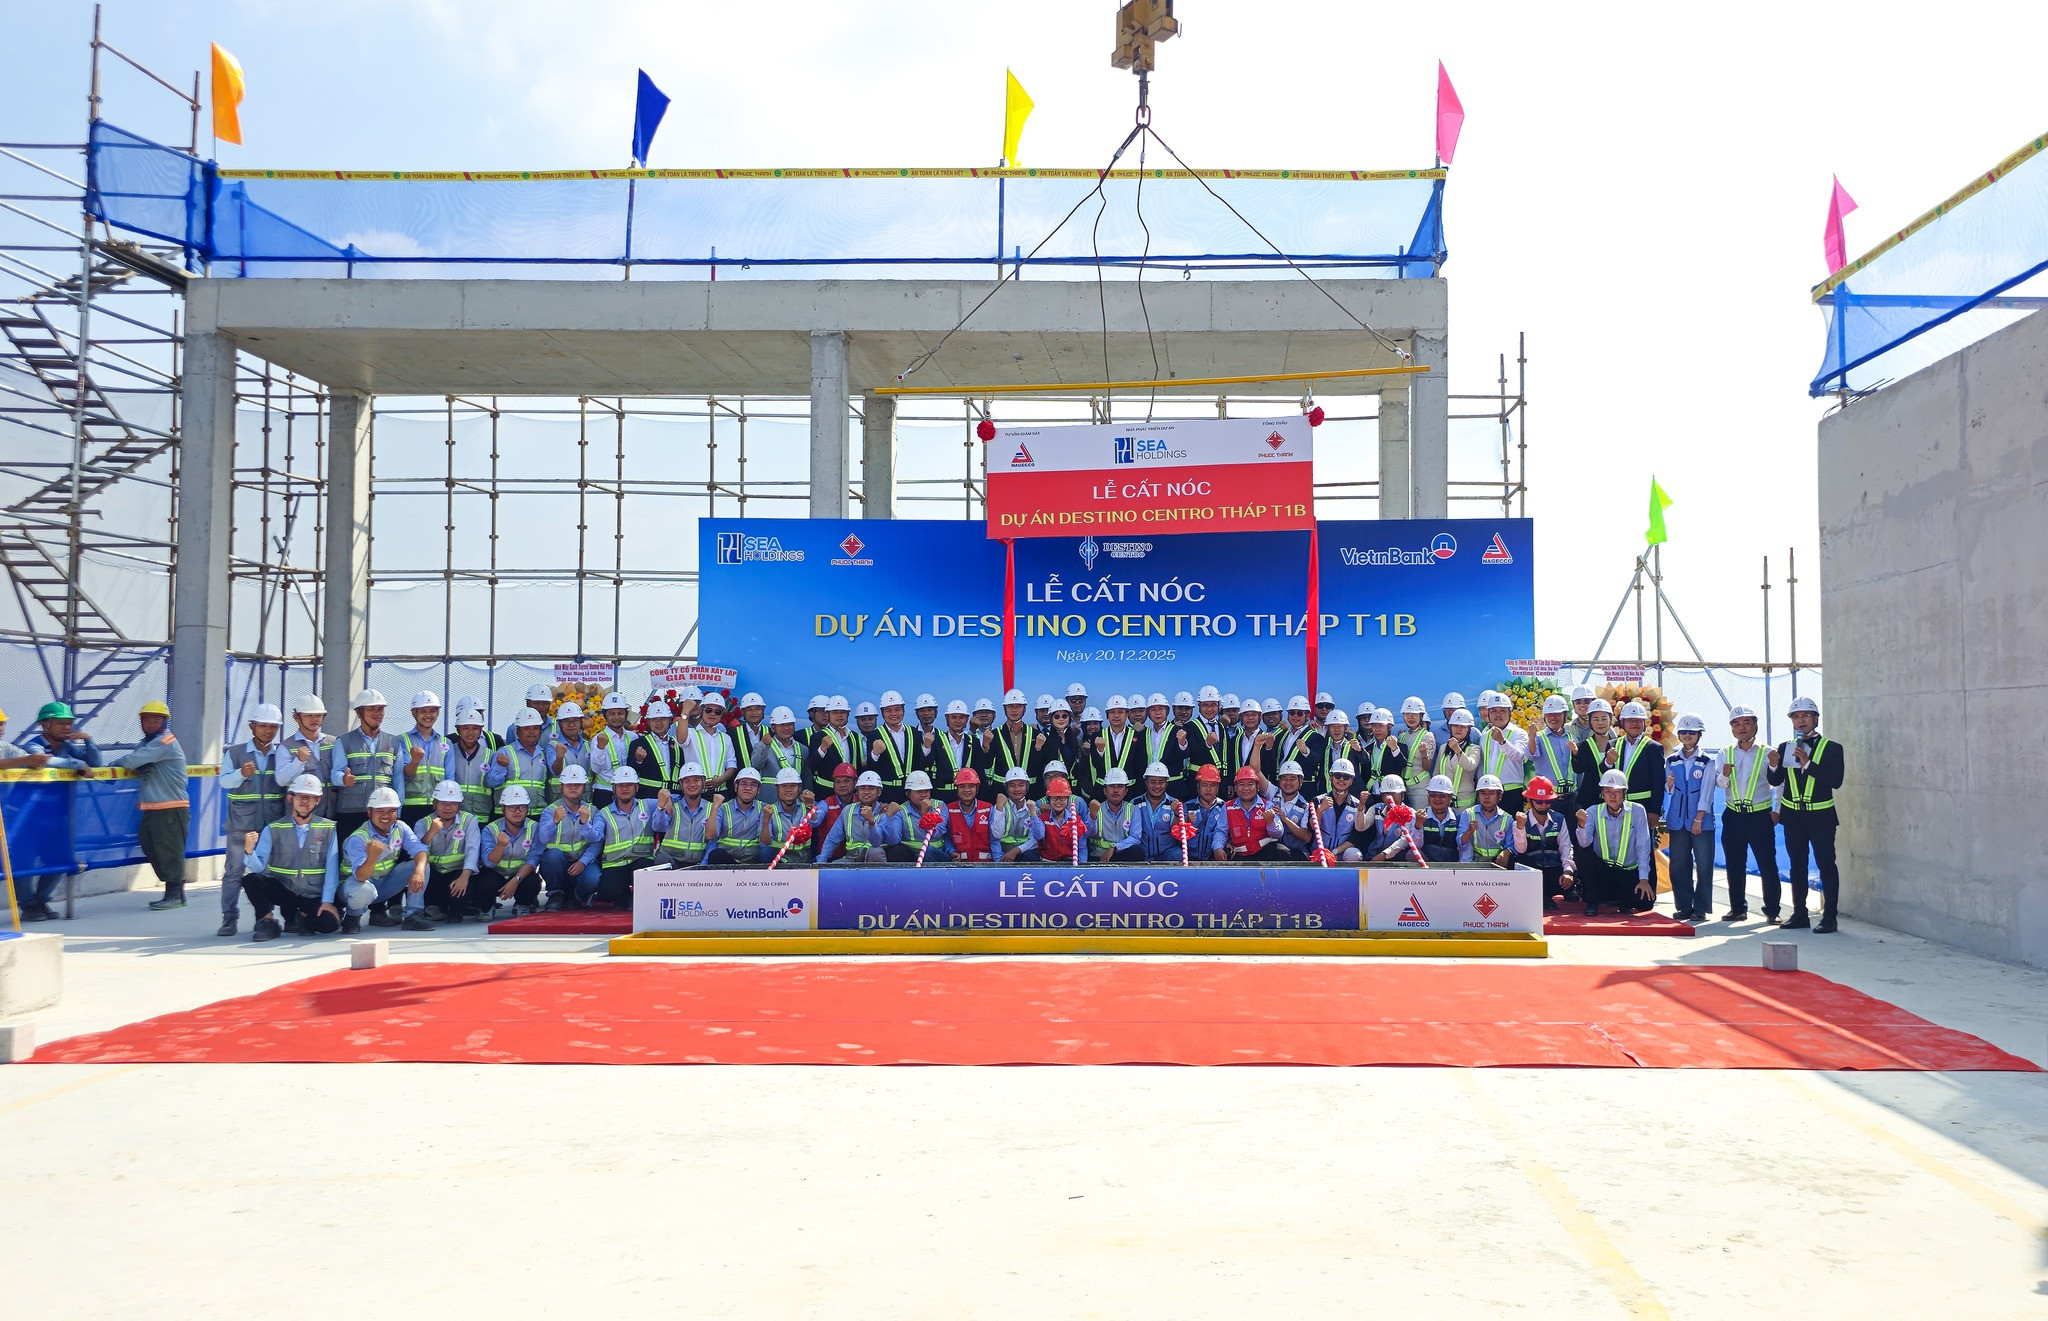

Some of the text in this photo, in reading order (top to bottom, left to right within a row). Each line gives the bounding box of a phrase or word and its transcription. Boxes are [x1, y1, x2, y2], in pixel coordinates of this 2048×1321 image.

[1137, 440, 1167, 451] SEA
[1137, 450, 1187, 460] HOLDINGS
[1093, 478, 1211, 499] LỄ CẤT NÓC
[1001, 502, 1306, 527] DỰ ÁN DESTINO CENTRO THÁP T1B
[744, 537, 782, 551] SEA
[1103, 542, 1153, 552] DESTINO
[744, 550, 804, 561] HOLDINGS
[1340, 547, 1436, 566] VietinBank
[1027, 573, 1206, 602] LỄ CẤT NÓC
[815, 614, 868, 642] DỰ
[874, 607, 922, 637] ÁN
[933, 614, 1087, 637] DESINO
[1096, 614, 1237, 637] CENTRO
[1347, 614, 1417, 637] T1B
[1056, 649, 1176, 664] Ngày 20.12.2025
[650, 668, 668, 676] CÔNG
[665, 674, 686, 682] GIA
[999, 873, 1179, 898] LỄ CẤT NÓC
[678, 901, 703, 910] SEA
[726, 907, 788, 919] VietinBank
[903, 909, 941, 928] ÁN
[949, 913, 1068, 928] DESTINO
[1075, 913, 1184, 928] CENTRO
[1191, 909, 1263, 929] THÁP
[1270, 913, 1323, 929] T1B
